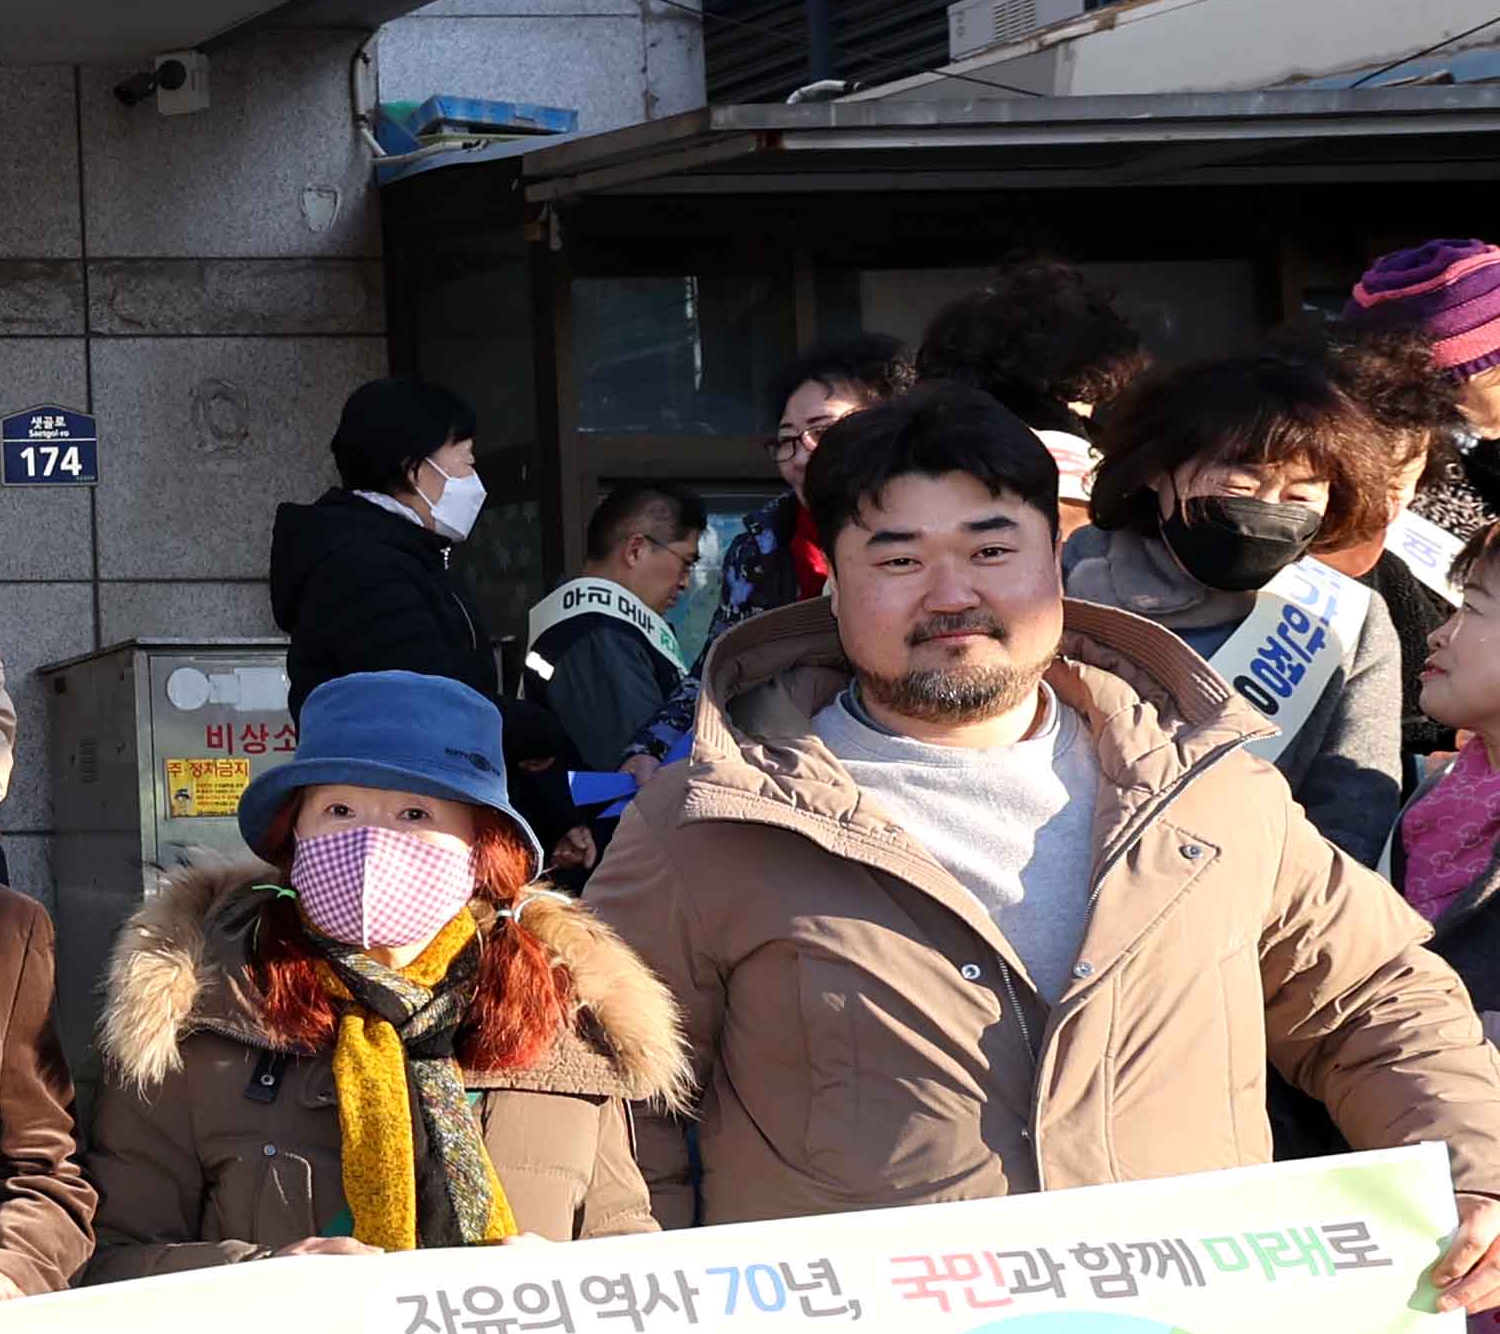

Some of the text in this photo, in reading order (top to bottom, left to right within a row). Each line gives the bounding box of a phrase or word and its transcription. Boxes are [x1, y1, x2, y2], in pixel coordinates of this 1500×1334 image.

[20, 446, 83, 477] 174
[563, 586, 612, 610] 우리
[580, 1269, 700, 1333] 역사
[889, 1245, 1067, 1313] 국민과
[1068, 1237, 1206, 1300] 함께
[1199, 1220, 1394, 1282] 미래로
